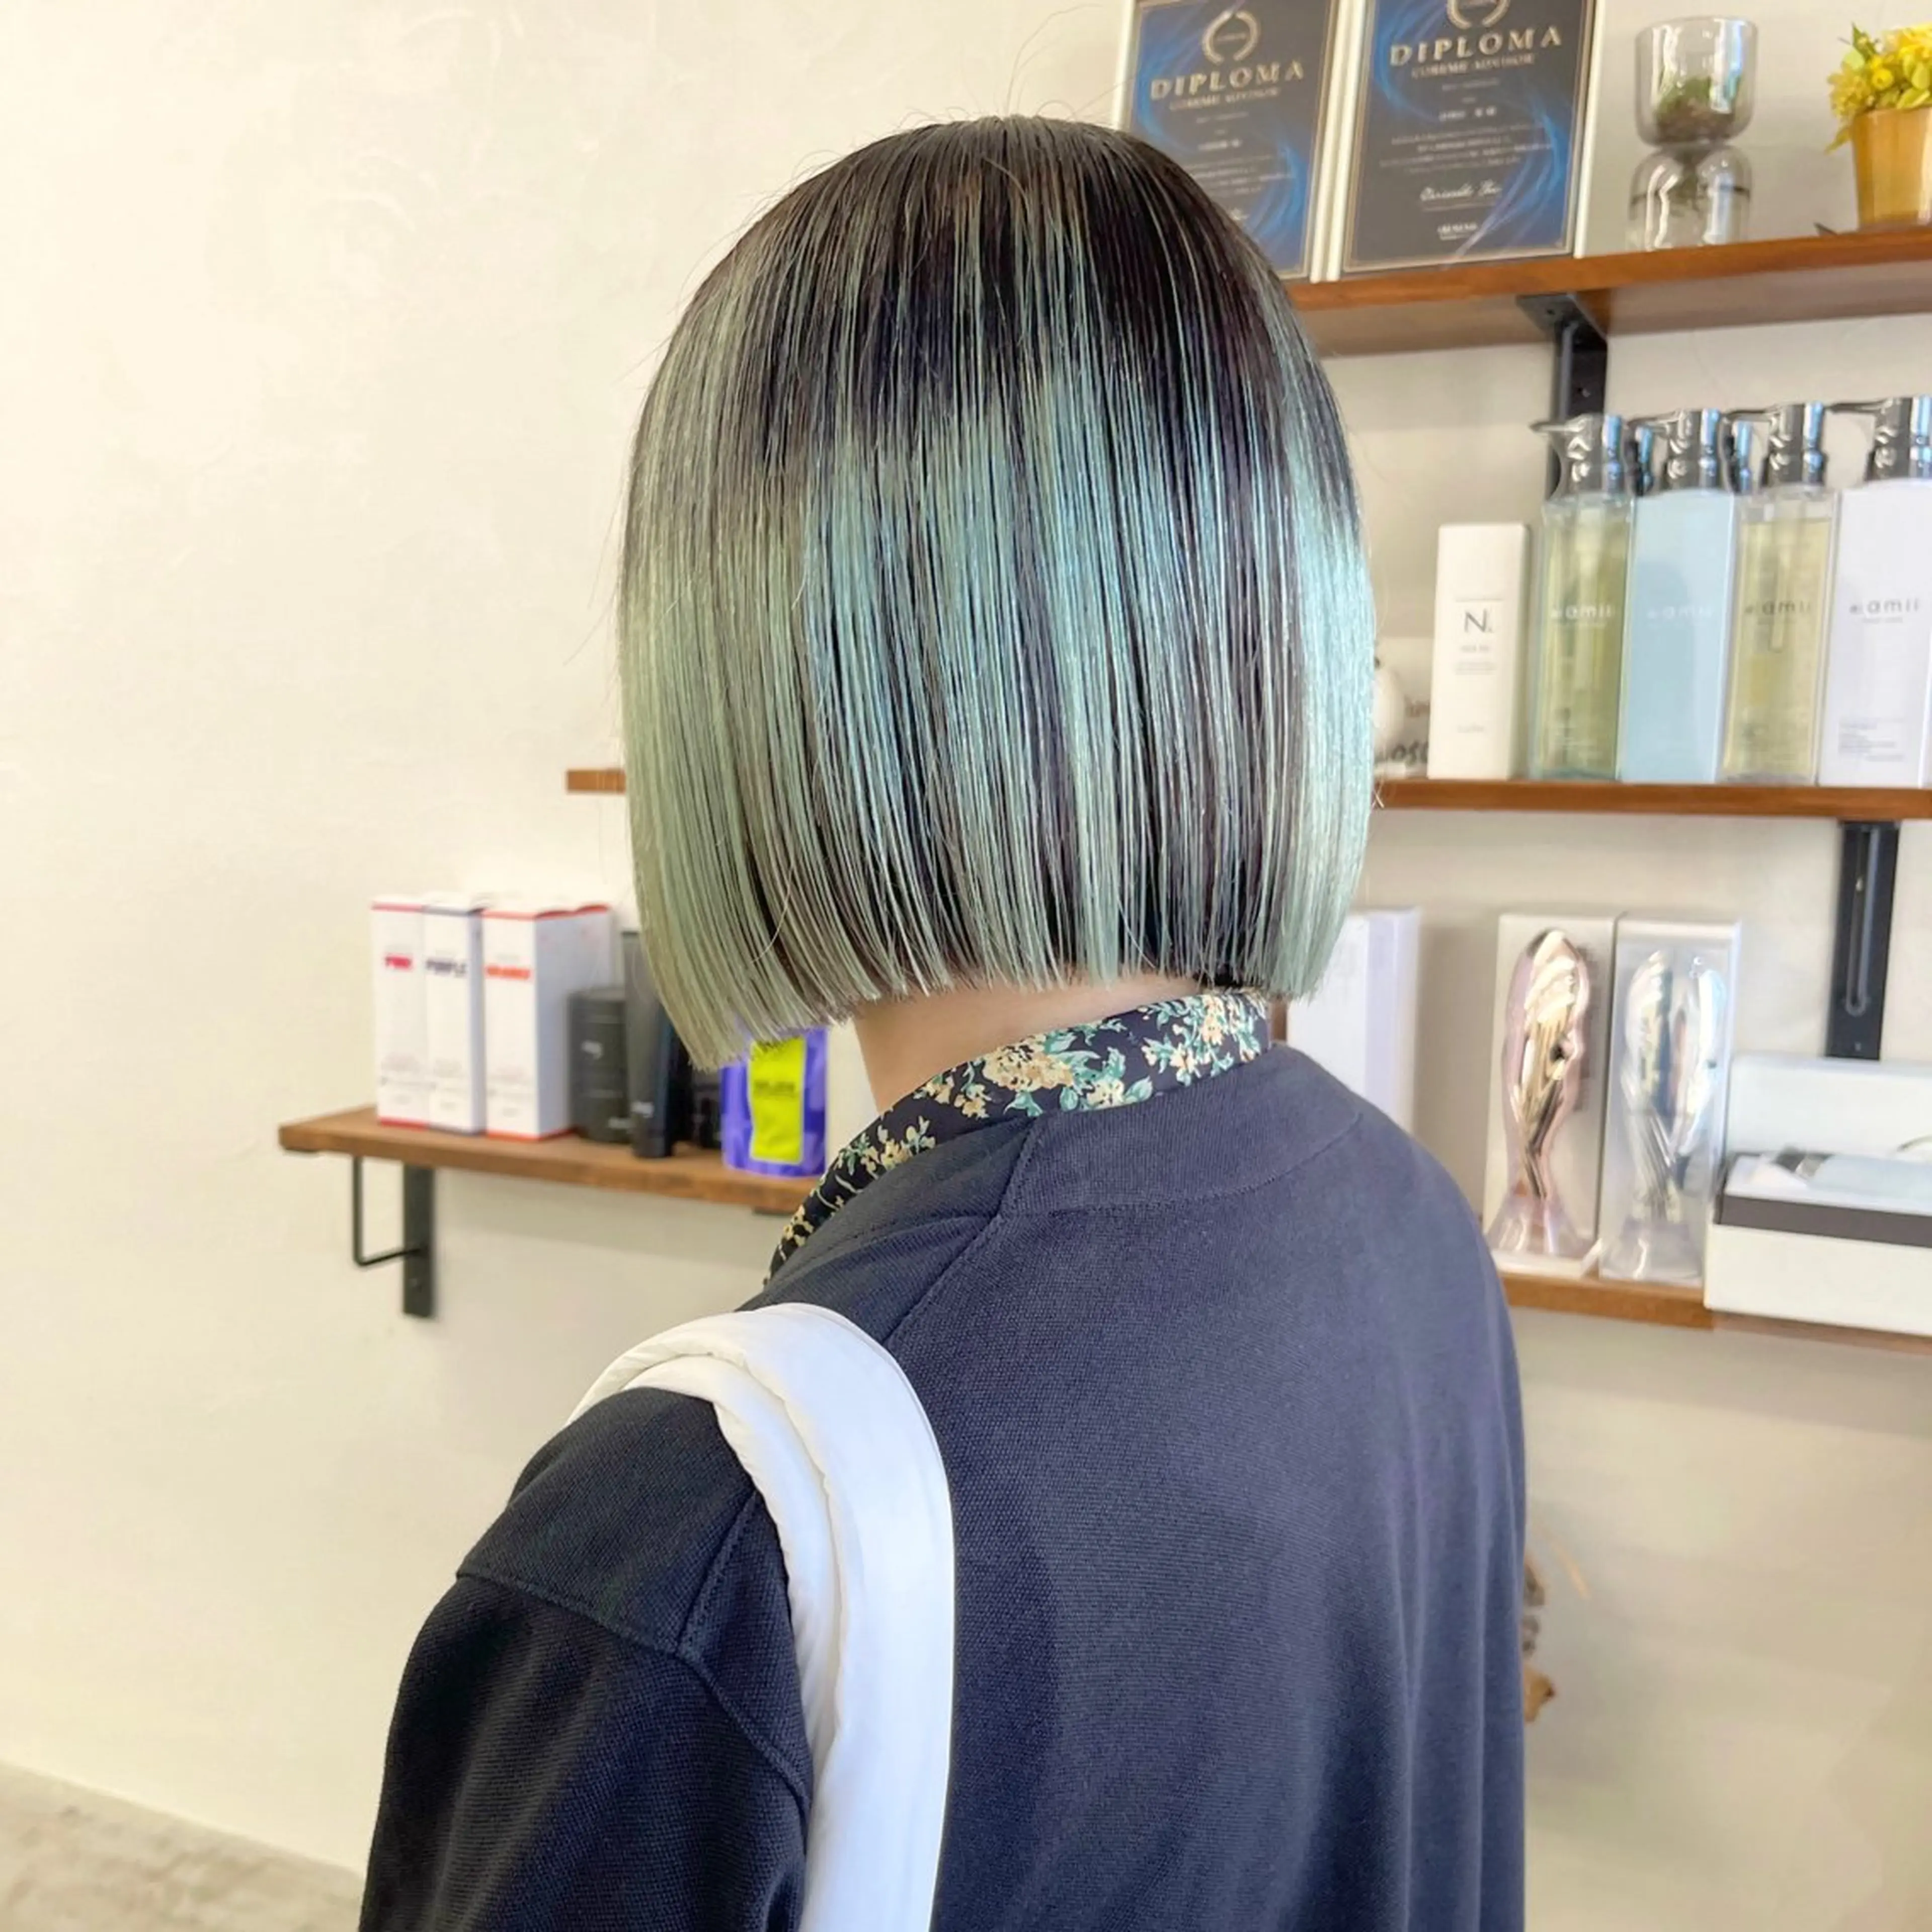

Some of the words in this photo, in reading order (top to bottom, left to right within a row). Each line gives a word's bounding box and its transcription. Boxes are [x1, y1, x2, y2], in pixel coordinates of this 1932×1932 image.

[1390, 26, 1561, 66] DIPLOMA
[1151, 60, 1305, 101] DIPLOMA
[1465, 608, 1493, 633] N.
